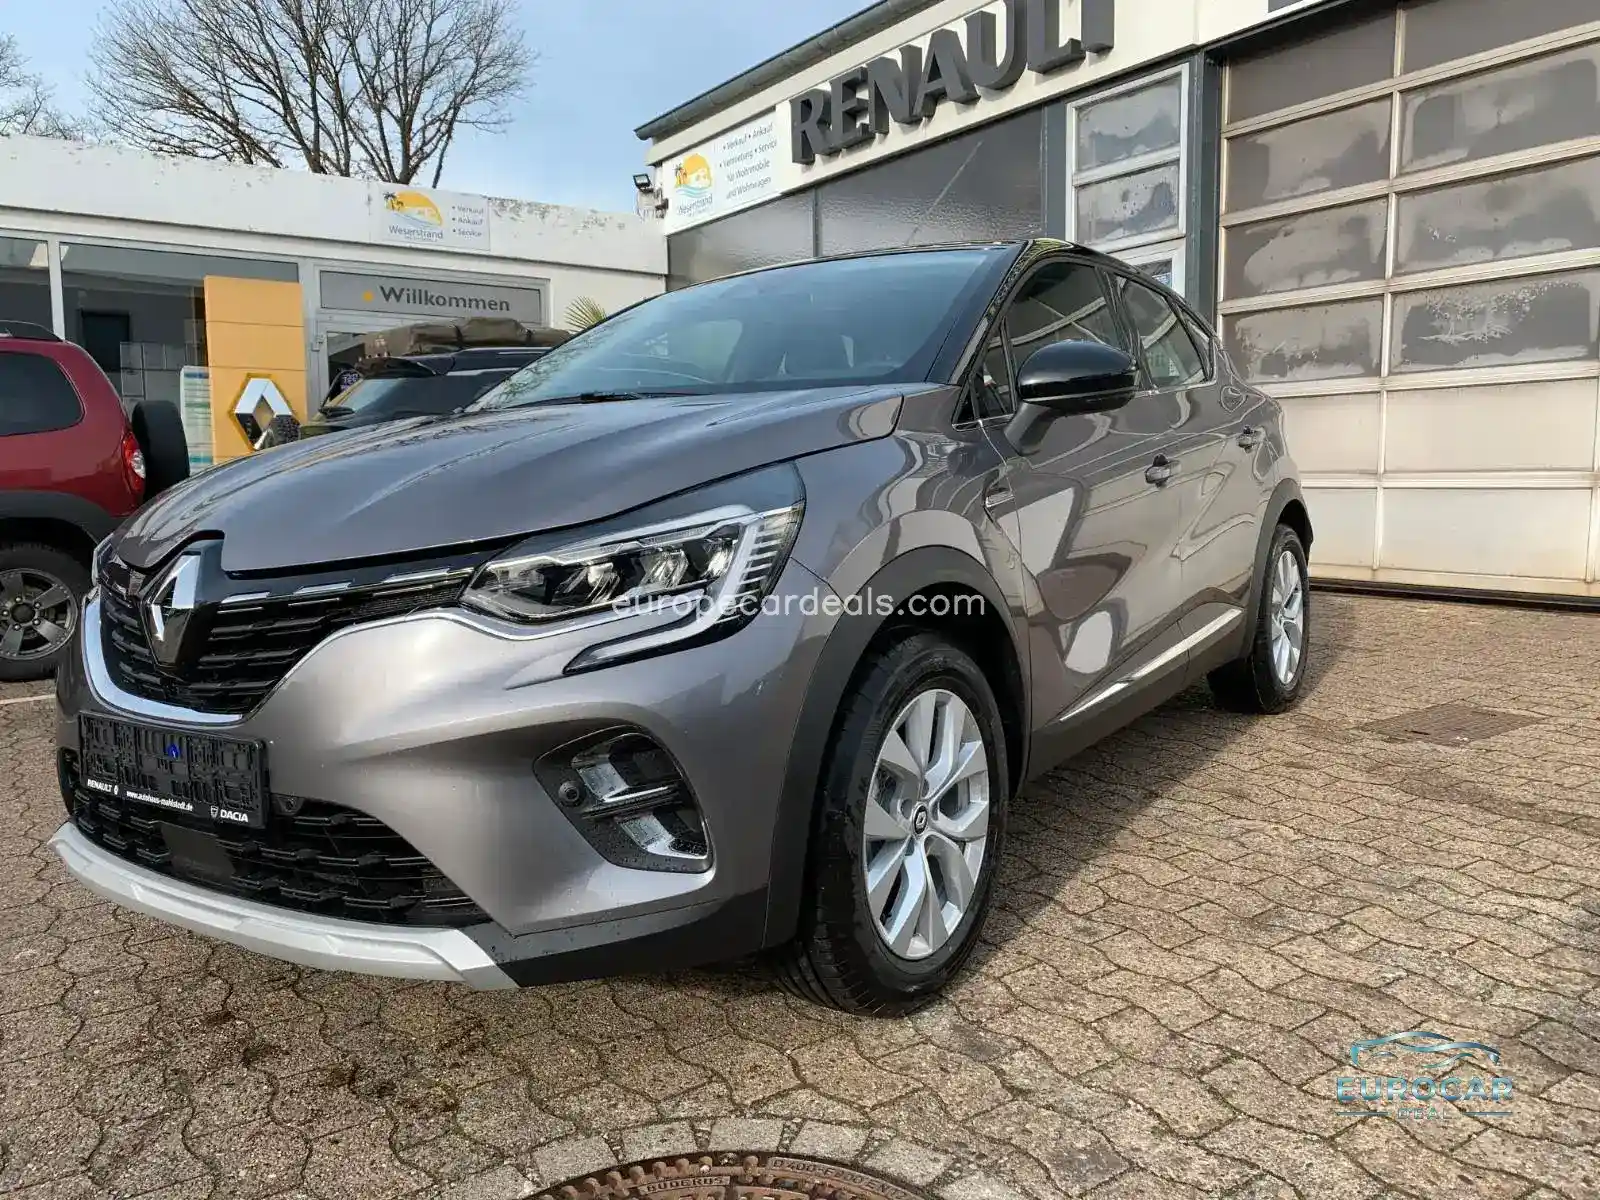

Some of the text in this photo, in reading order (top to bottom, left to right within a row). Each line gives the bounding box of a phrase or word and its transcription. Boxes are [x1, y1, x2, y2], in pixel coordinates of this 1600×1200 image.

[752, 123, 773, 138] Ankauf
[389, 225, 443, 239] Weserstrand
[379, 285, 511, 312] Willkommen
[87, 778, 114, 793] RENAULT
[220, 808, 249, 823] DACIA
